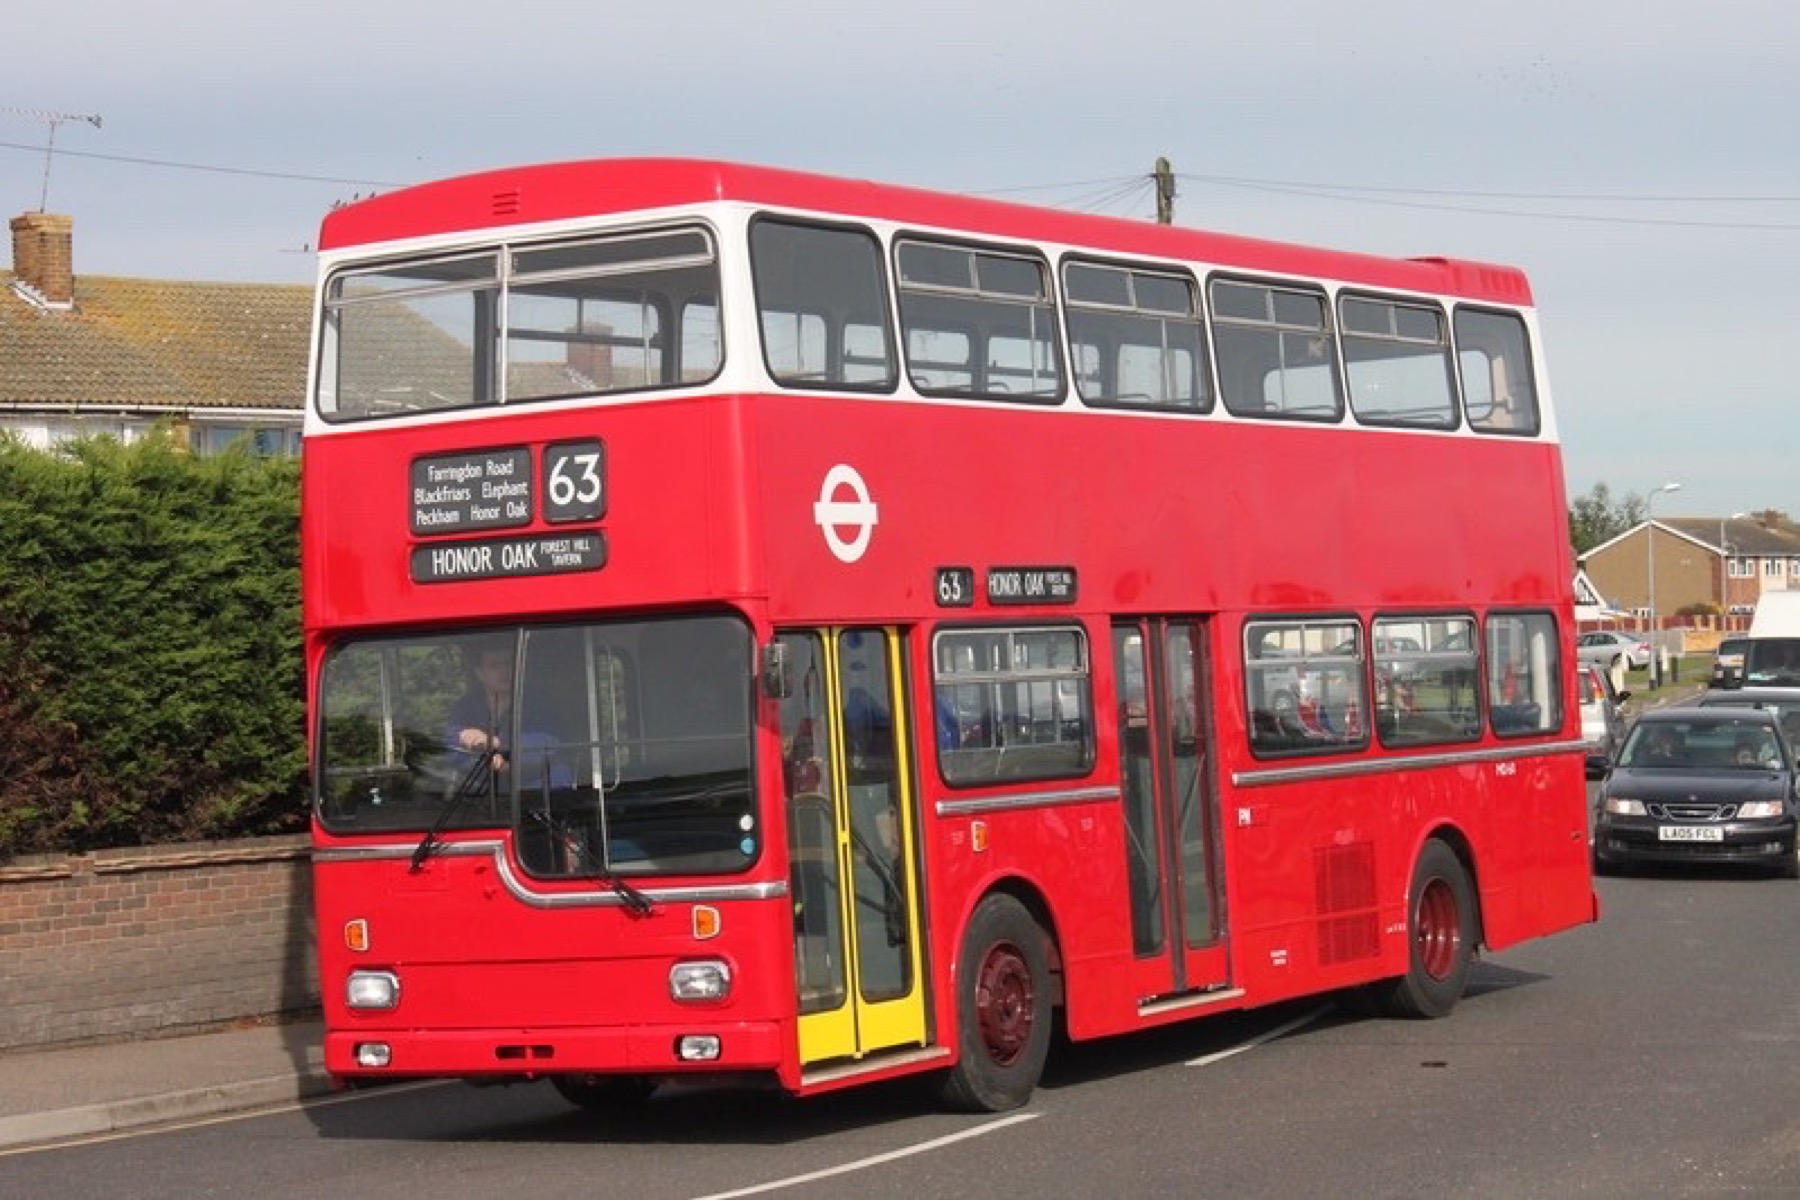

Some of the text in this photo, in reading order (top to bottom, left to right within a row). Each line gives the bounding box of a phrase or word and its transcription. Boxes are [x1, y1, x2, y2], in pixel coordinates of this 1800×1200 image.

[427, 459, 514, 483] Farringdon Road
[549, 453, 601, 505] 63
[414, 480, 528, 505] Blackfriars Elephant
[416, 501, 528, 526] Peckham Honor Oak
[431, 541, 539, 575] HONOR OAK
[540, 538, 590, 554] FOREST HILL
[551, 553, 582, 566] TAVERN
[939, 572, 961, 601] 63
[988, 571, 1023, 596] HONOR
[1024, 571, 1046, 595] OAK
[1663, 828, 1693, 839] LA05
